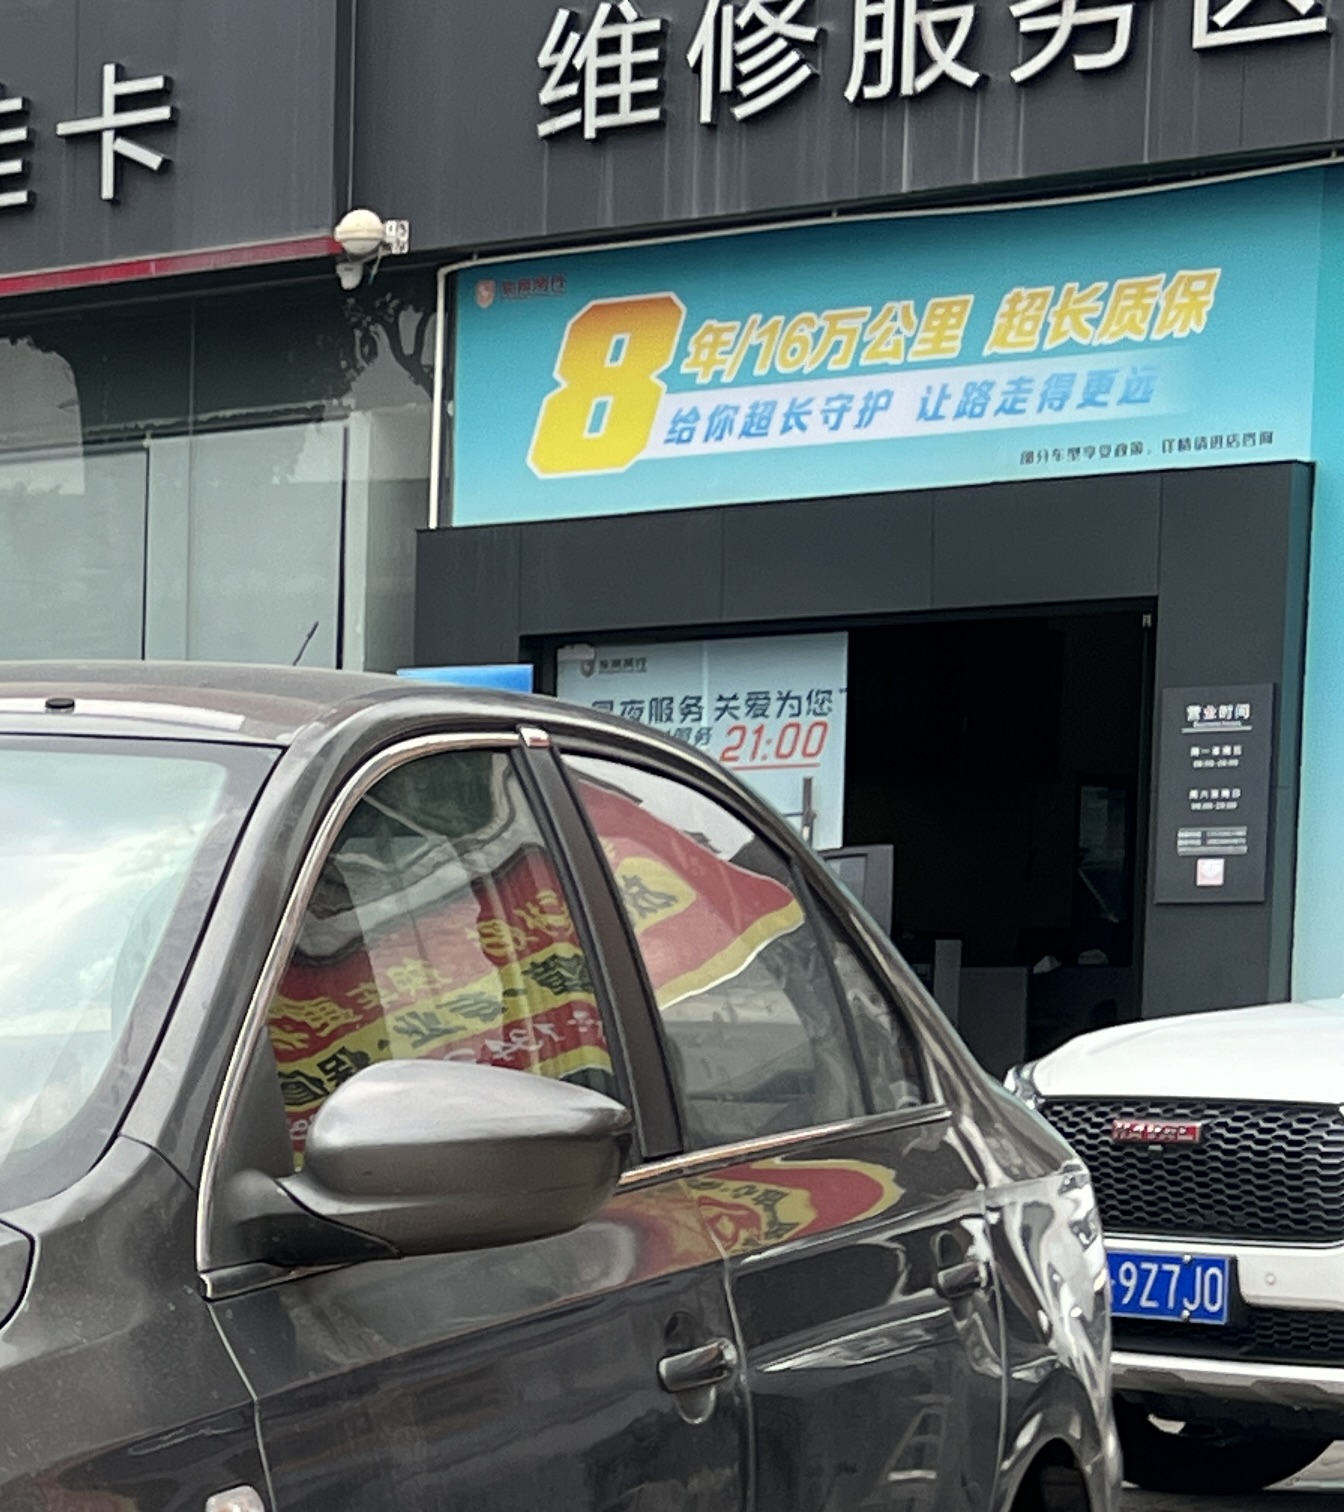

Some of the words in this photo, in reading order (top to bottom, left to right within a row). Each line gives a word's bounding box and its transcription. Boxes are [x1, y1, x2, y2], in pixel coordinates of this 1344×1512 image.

[983, 268, 1222, 357] 超长质保
[663, 390, 895, 446] 给你超长守护
[916, 365, 1160, 423] 让路走得更远
[719, 719, 830, 763] 21:00
